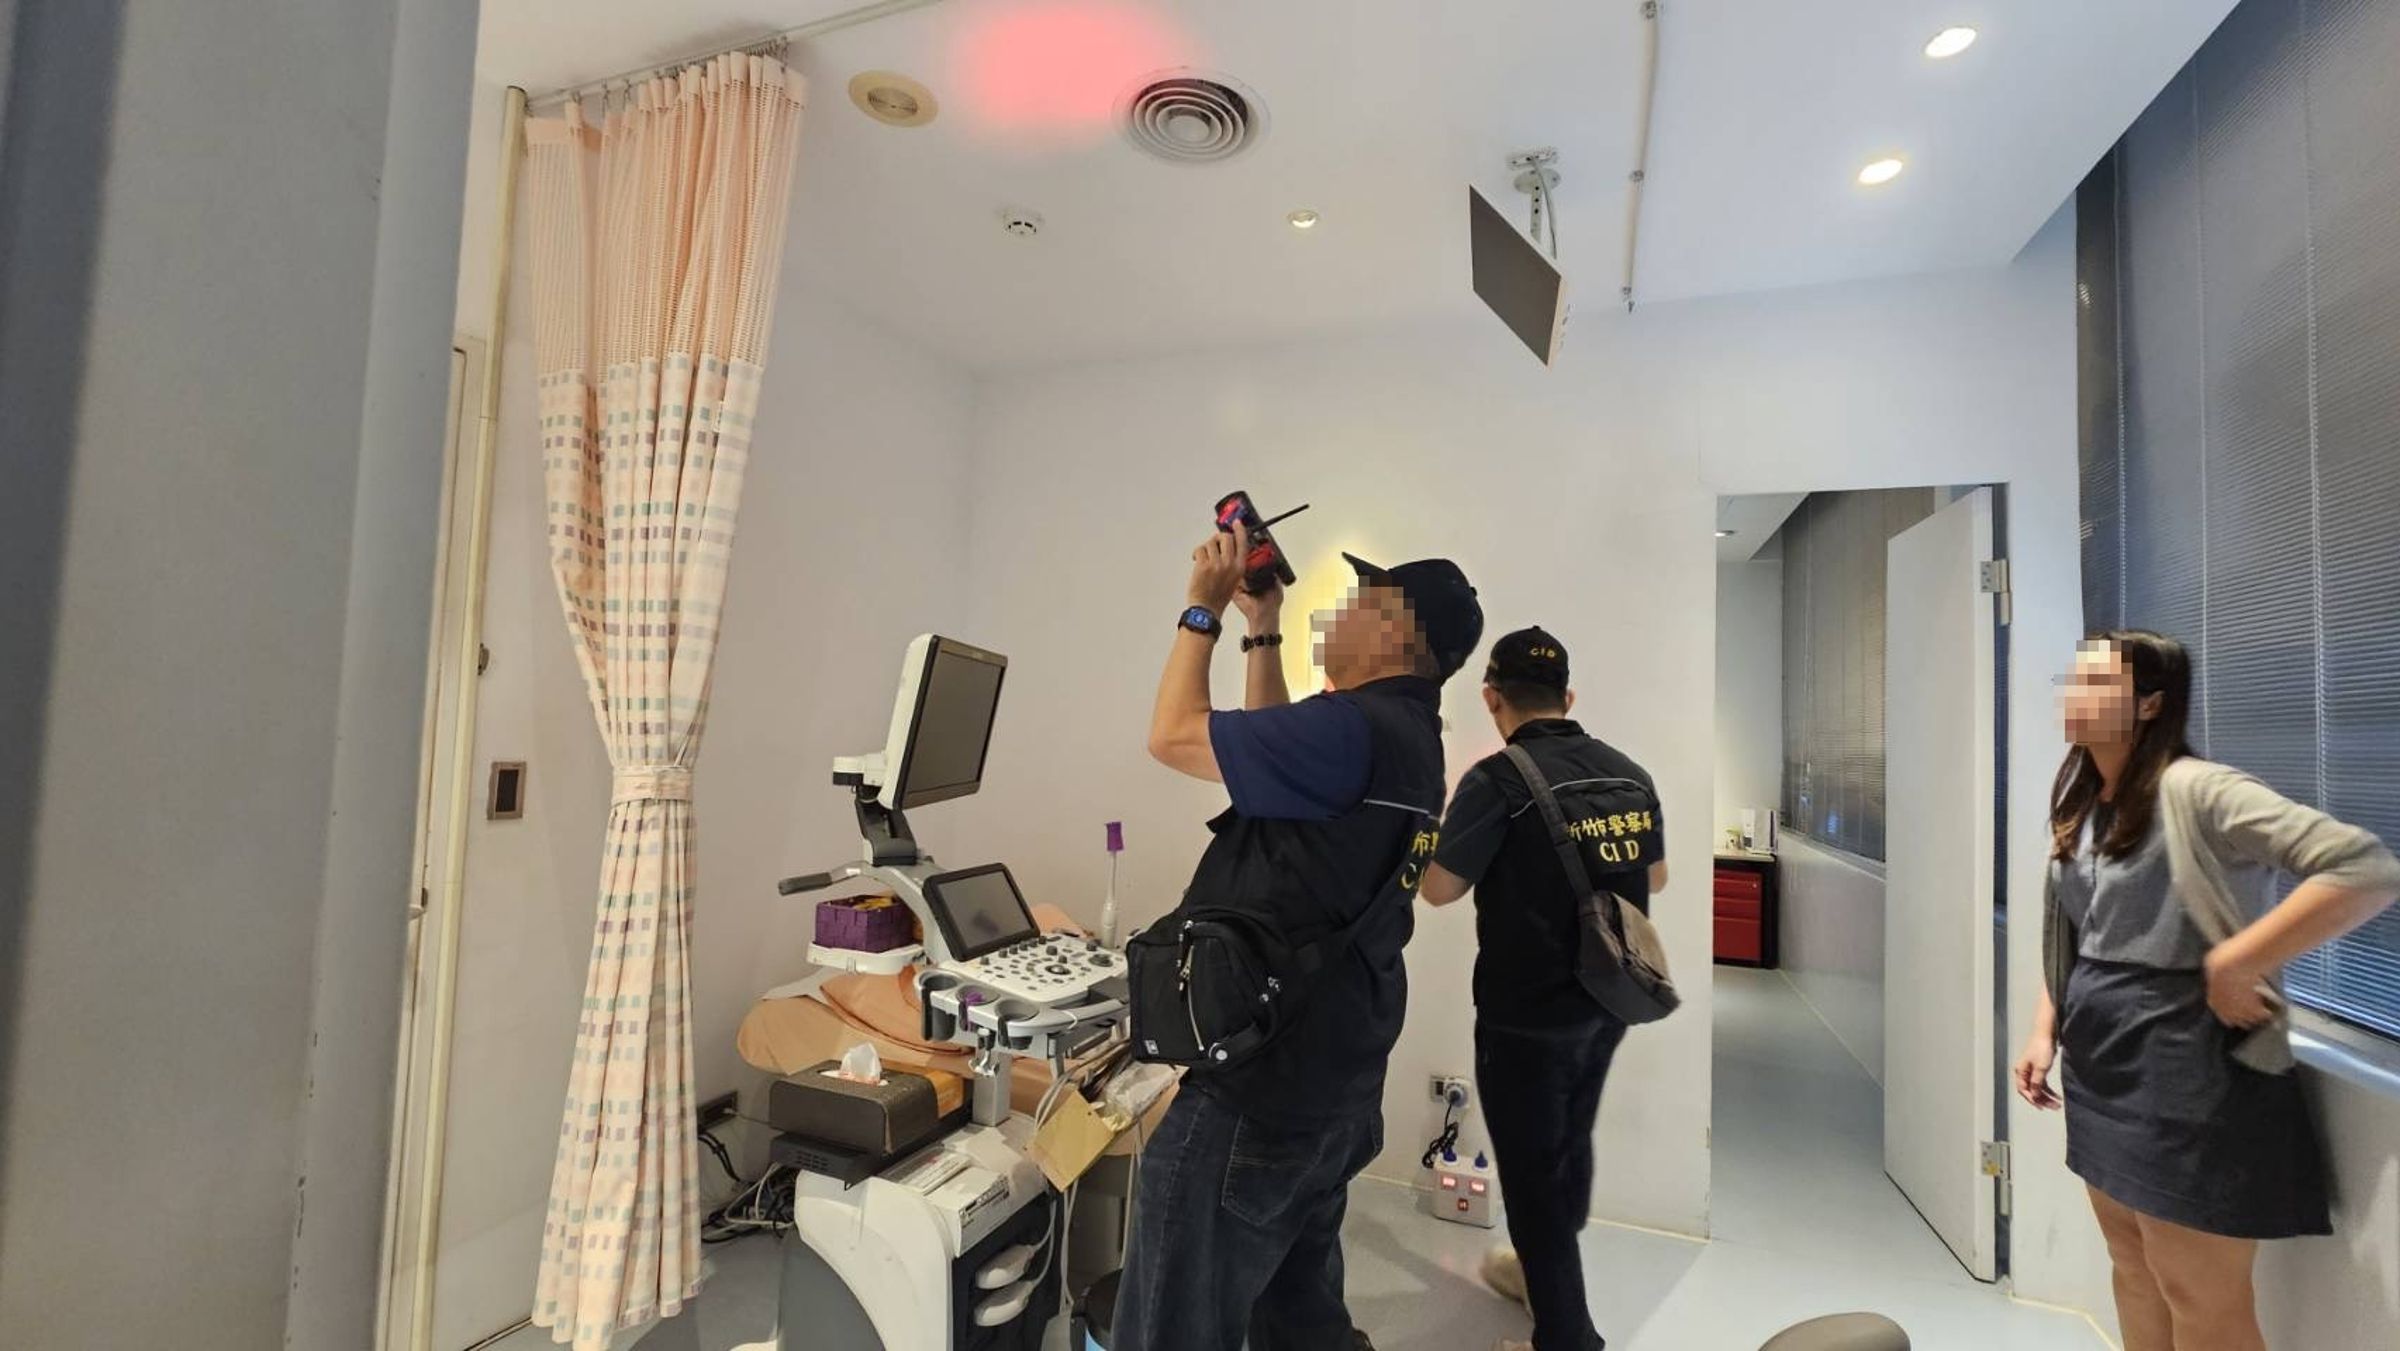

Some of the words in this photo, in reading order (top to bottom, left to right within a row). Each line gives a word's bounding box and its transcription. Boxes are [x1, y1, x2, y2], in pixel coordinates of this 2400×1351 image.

[1530, 648, 1556, 658] CID
[1411, 830, 1439, 856] 市
[1599, 840, 1640, 862] CID
